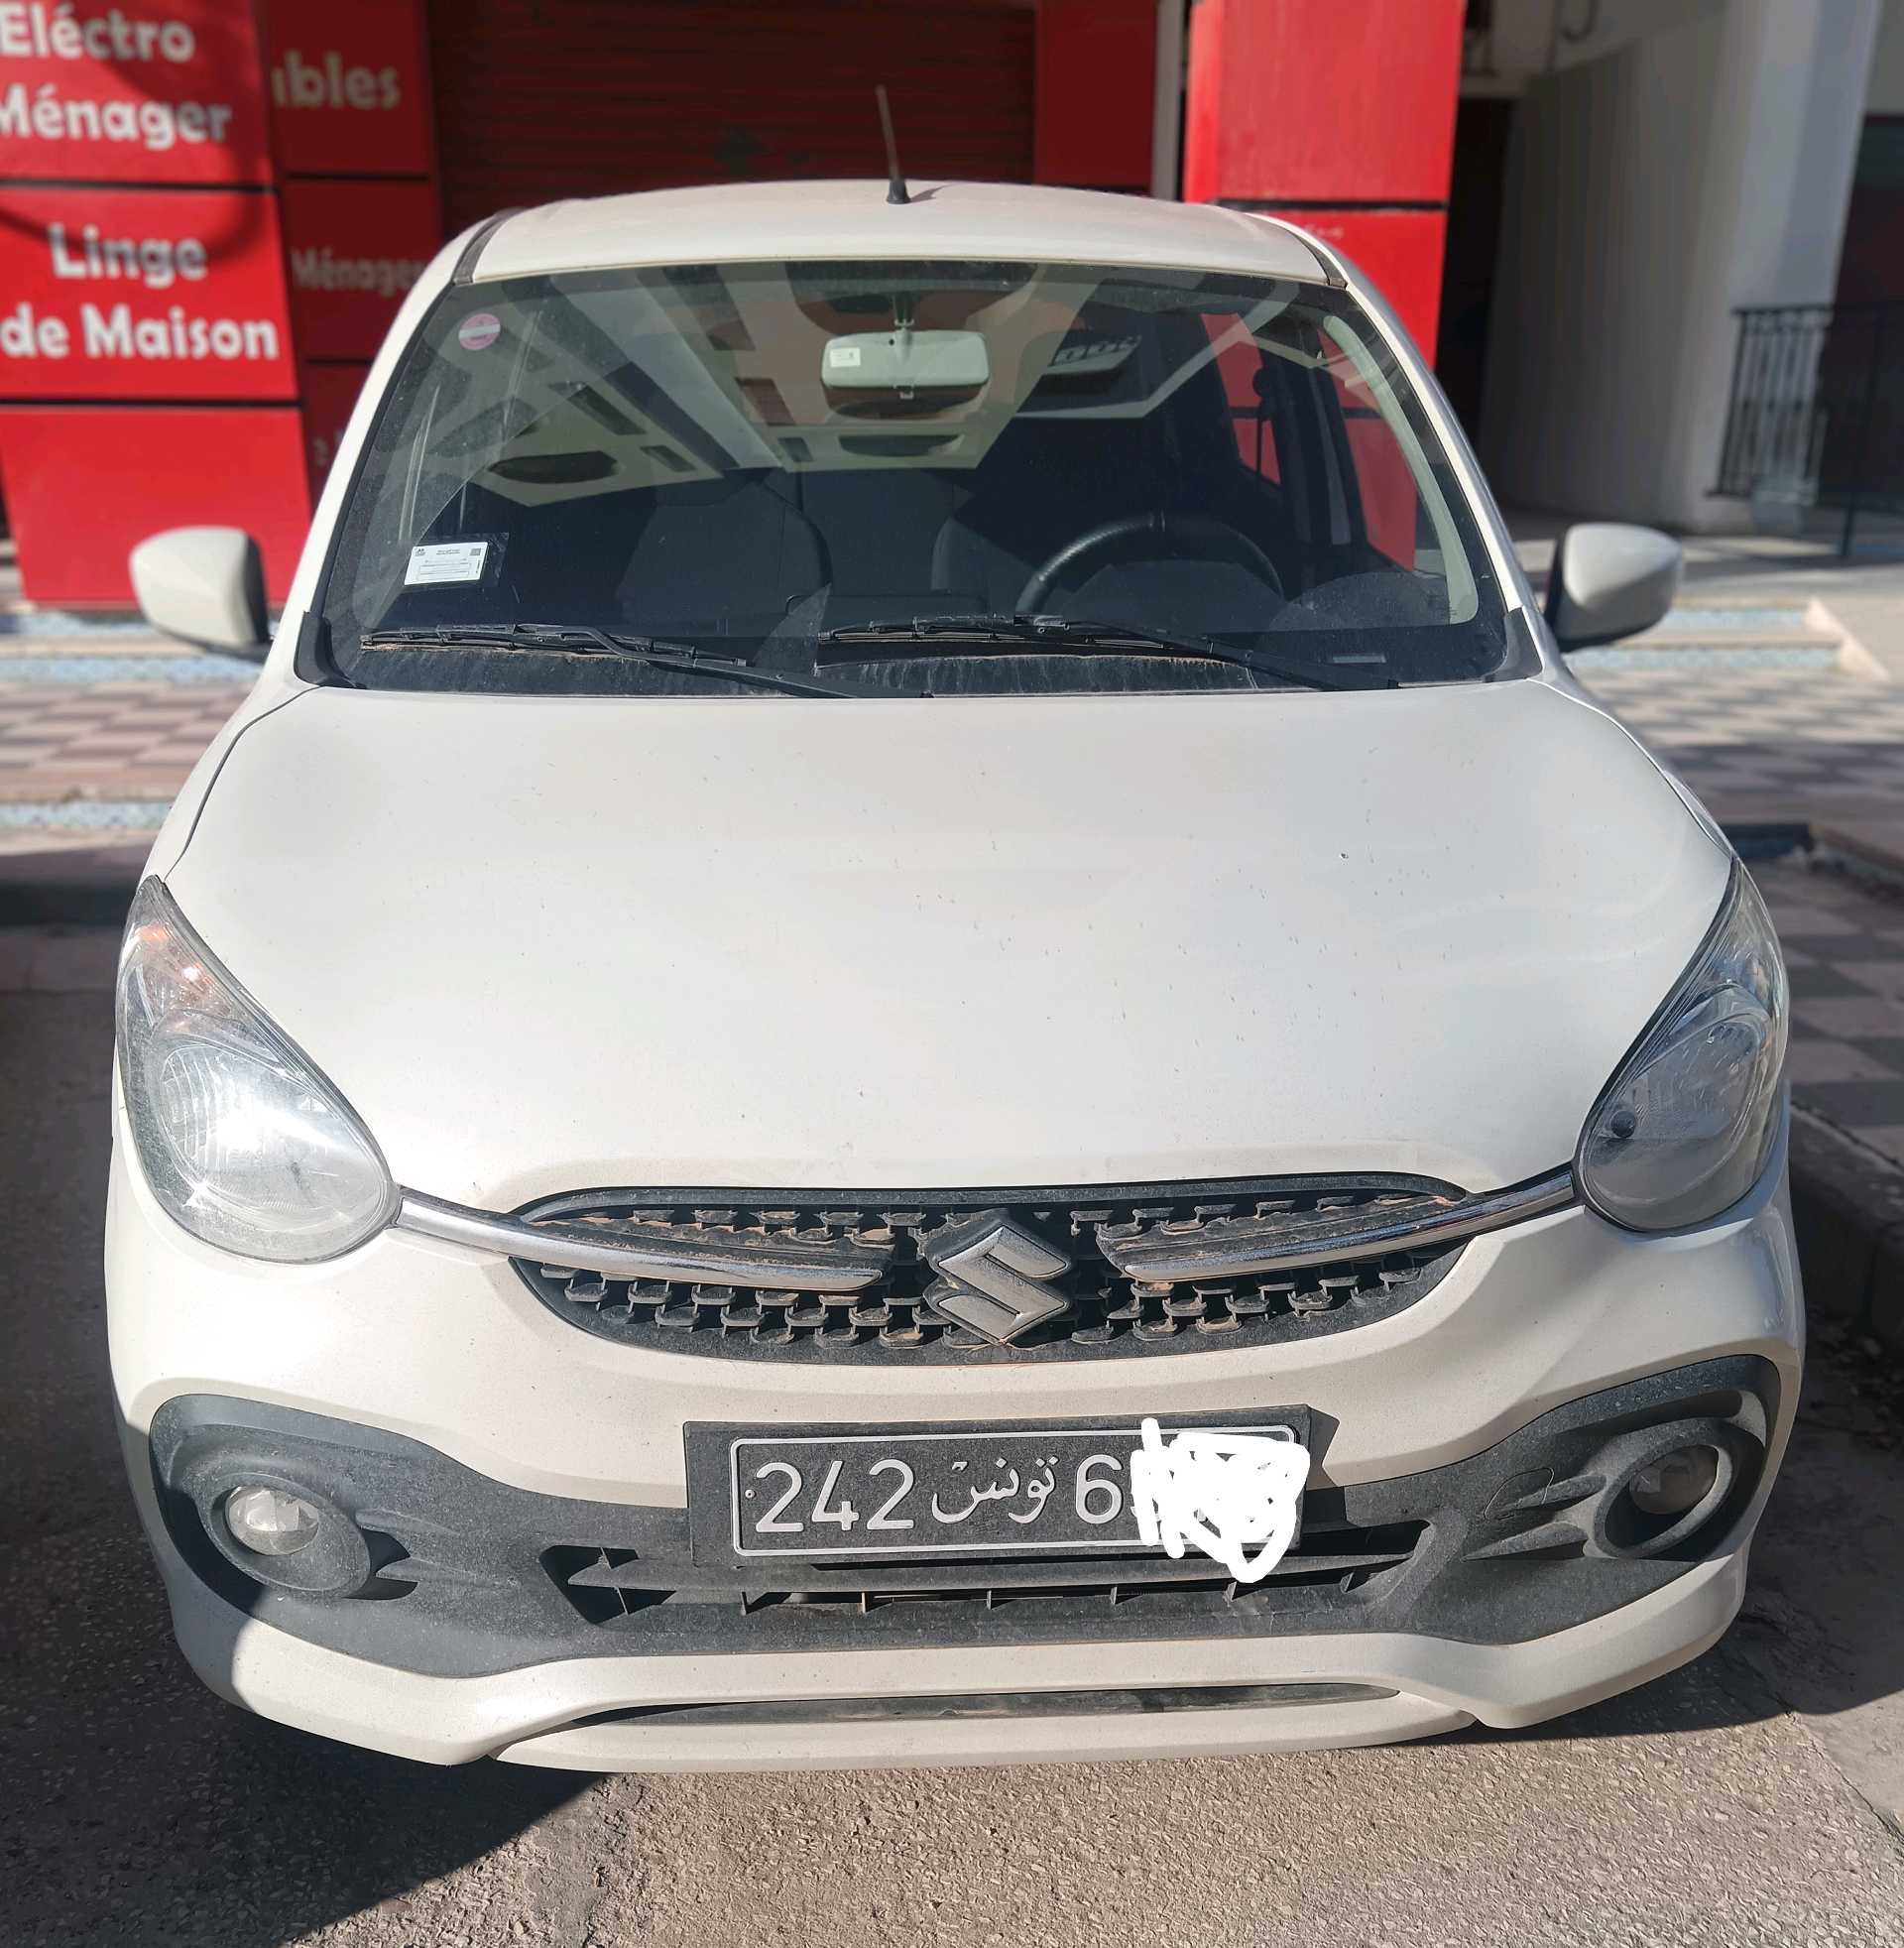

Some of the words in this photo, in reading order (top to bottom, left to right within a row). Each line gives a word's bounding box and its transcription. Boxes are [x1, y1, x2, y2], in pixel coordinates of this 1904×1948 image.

[0, 1, 195, 63] Eléctro
[49, 222, 206, 289] Linge
[0, 302, 69, 358] de
[80, 303, 279, 359] Maison
[756, 1459, 914, 1532] 242
[932, 1456, 1059, 1523] تونس
